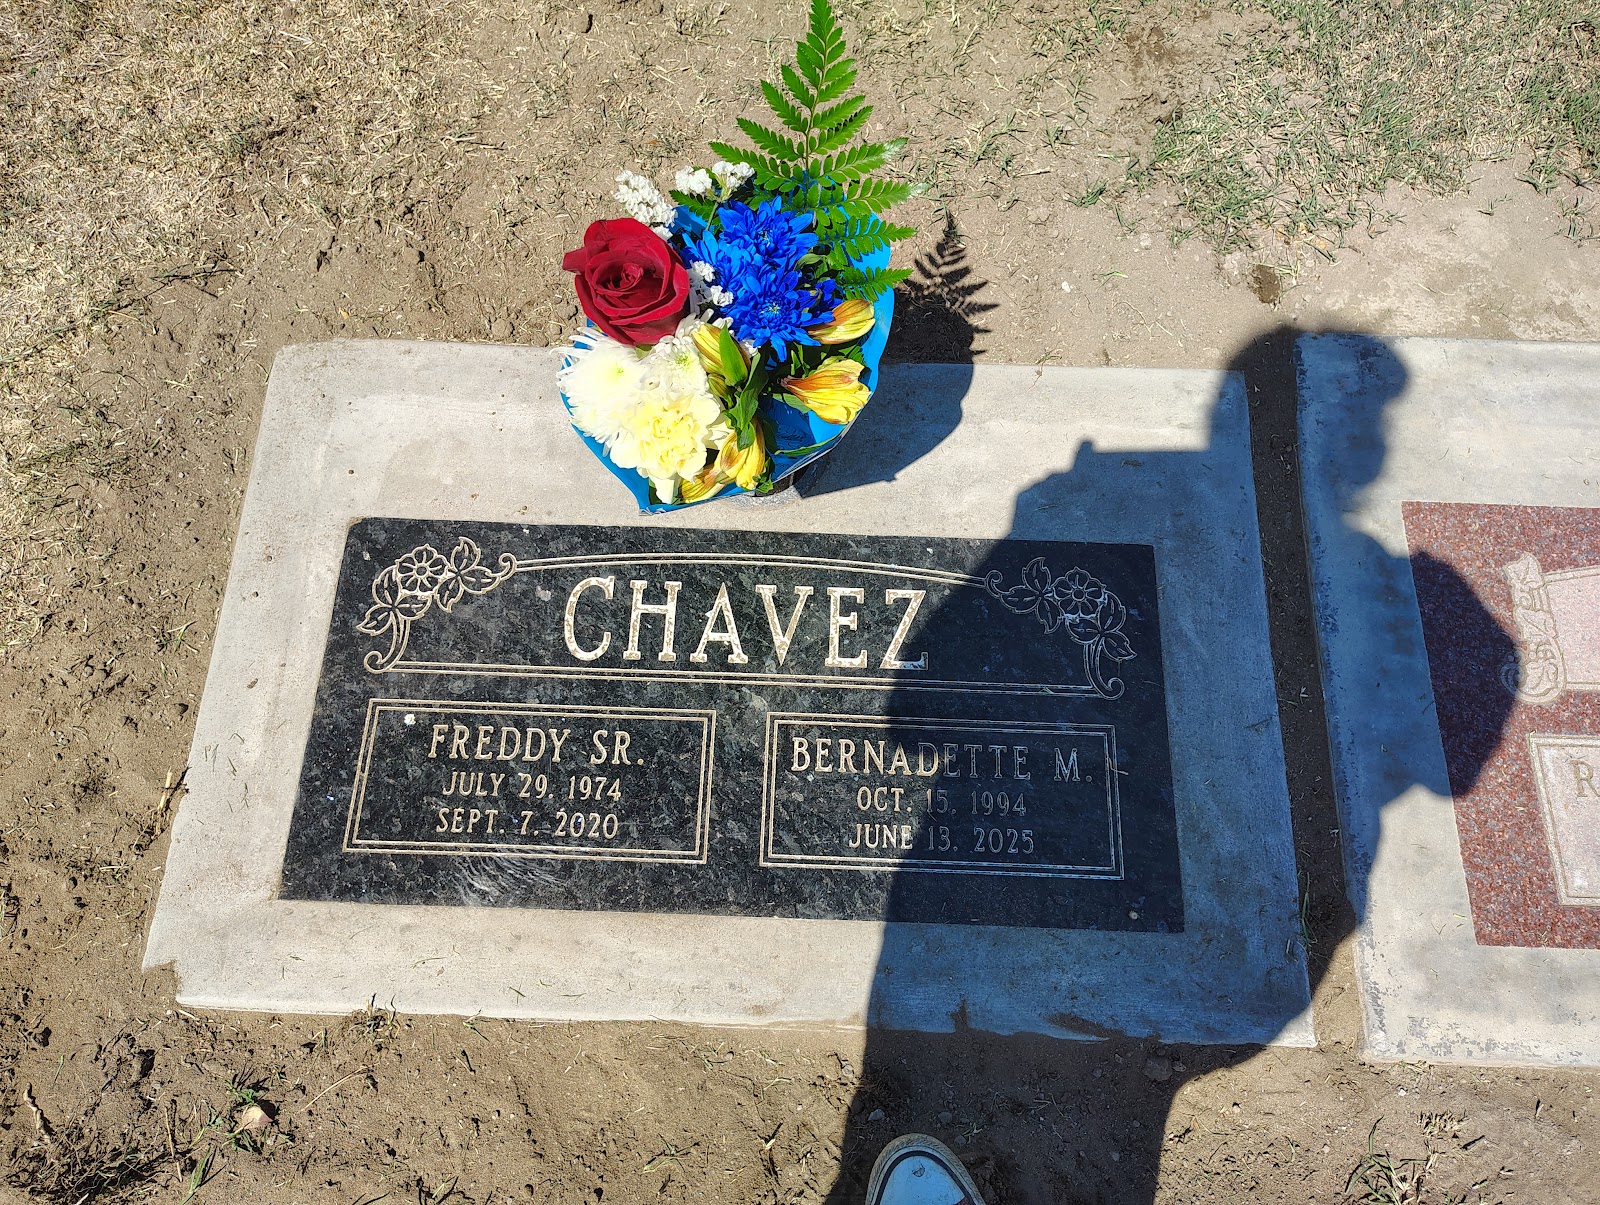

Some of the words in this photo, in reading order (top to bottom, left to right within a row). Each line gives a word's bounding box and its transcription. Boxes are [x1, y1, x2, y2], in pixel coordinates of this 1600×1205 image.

[563, 575, 929, 670] CHAVEZ
[428, 724, 571, 763] FREDDY
[590, 729, 645, 766] SR.
[790, 736, 1031, 781] BERNADETTE
[1053, 747, 1093, 783] M.
[442, 771, 505, 797] JULY
[568, 775, 621, 801] 1974
[856, 786, 913, 812] OCT.
[970, 791, 1027, 817] 1994
[435, 807, 504, 834] SEPT.
[555, 811, 619, 840] 2020
[849, 823, 913, 851] JUNE
[973, 826, 1035, 854] 2025
